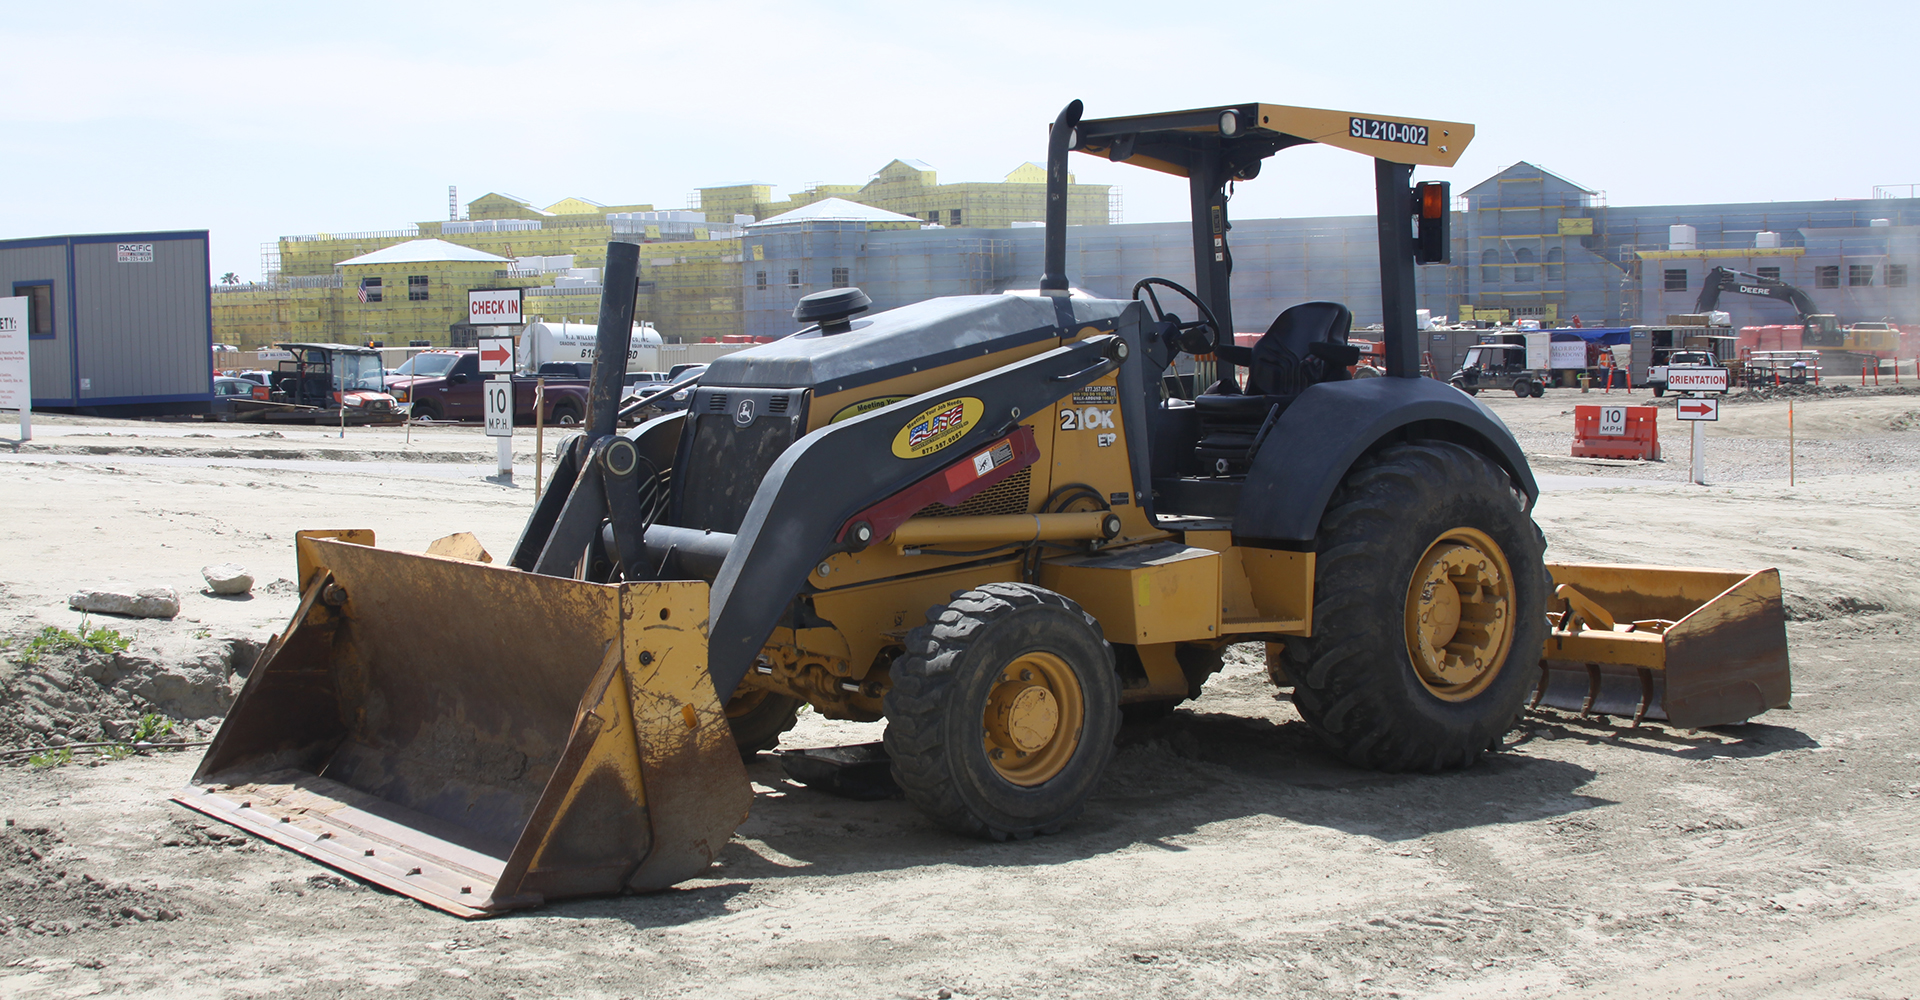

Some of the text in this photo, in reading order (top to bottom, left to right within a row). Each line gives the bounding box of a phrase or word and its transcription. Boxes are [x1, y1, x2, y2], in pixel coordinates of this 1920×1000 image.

[1351, 118, 1426, 145] SL210-002
[1740, 285, 1770, 295] DEERE
[471, 299, 518, 315] CHECK IN
[1669, 375, 1726, 385] ORIENTATION
[489, 388, 507, 414] 10
[857, 400, 885, 412] Meeting
[488, 418, 510, 430] M.P.H.
[906, 414, 925, 430] Meeting
[925, 408, 937, 417] Your
[1060, 406, 1115, 431] 210K
[1605, 410, 1621, 423] 10
[909, 403, 964, 447] ELITE
[922, 431, 962, 455] 877.357.0057
[1097, 433, 1117, 447] EP
